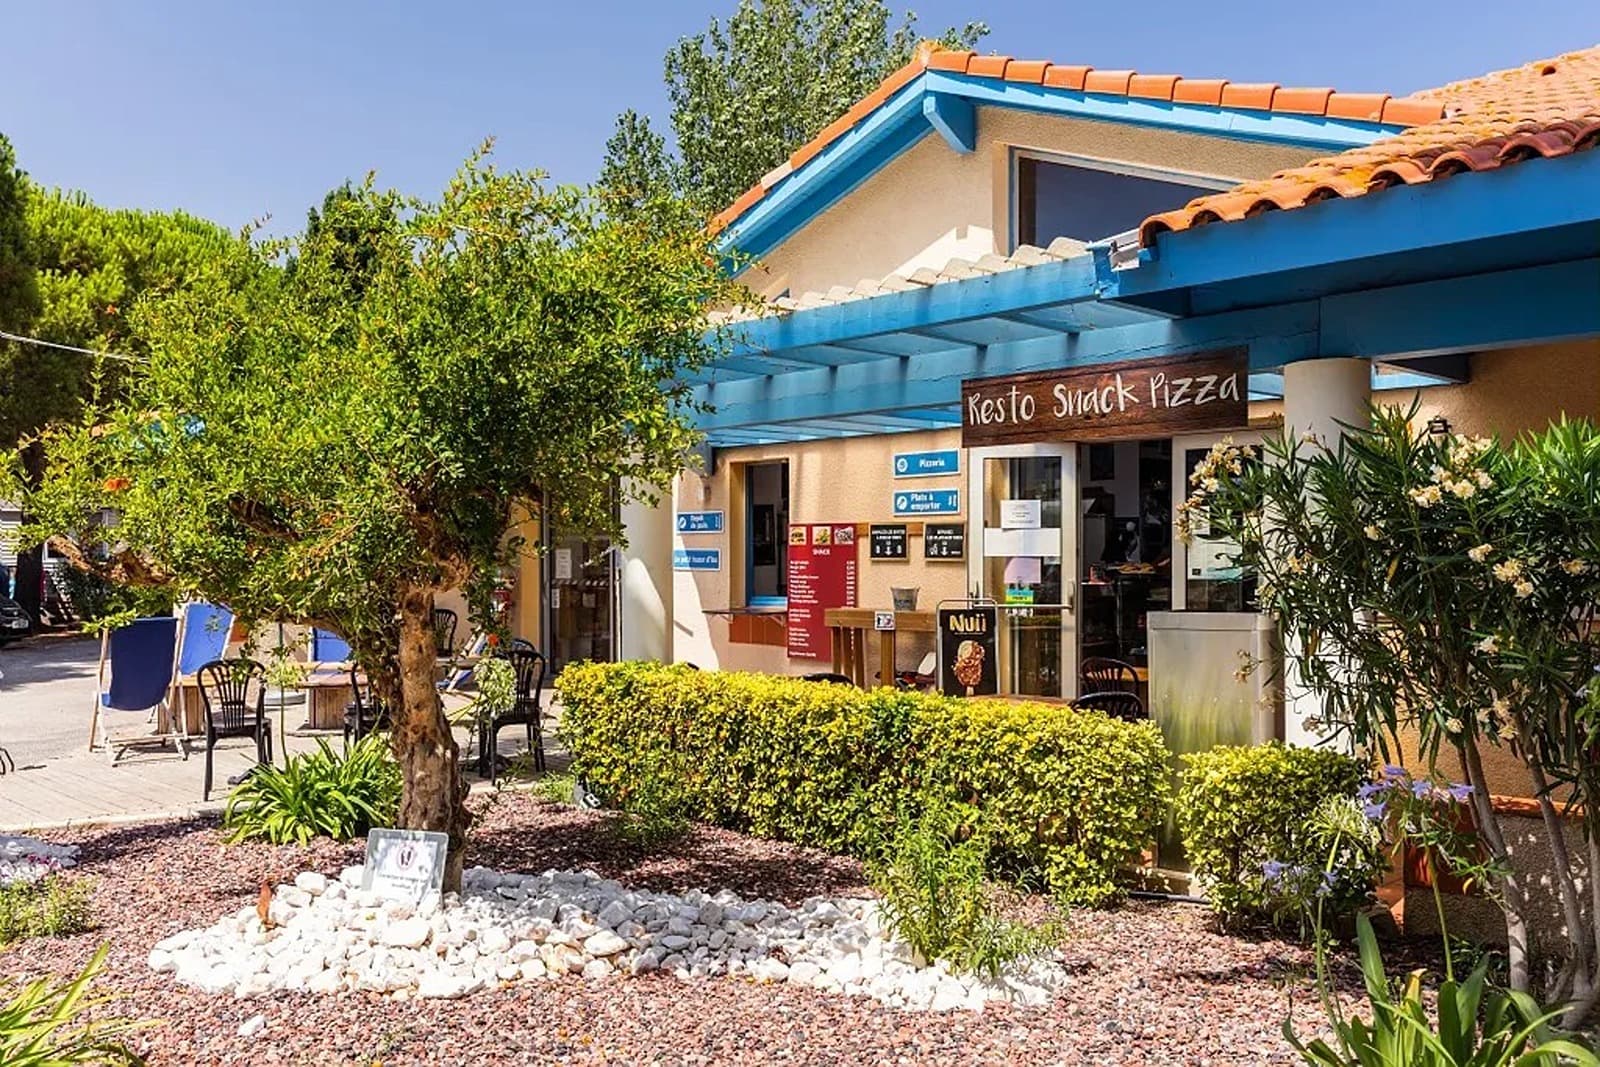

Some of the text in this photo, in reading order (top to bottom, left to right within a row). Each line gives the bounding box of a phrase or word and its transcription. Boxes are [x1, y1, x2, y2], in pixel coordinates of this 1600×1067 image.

[968, 372, 1240, 426] Resto Snack Pizza
[919, 458, 945, 468] Pizzeria
[910, 493, 928, 502] Plats
[910, 502, 942, 511] emporter
